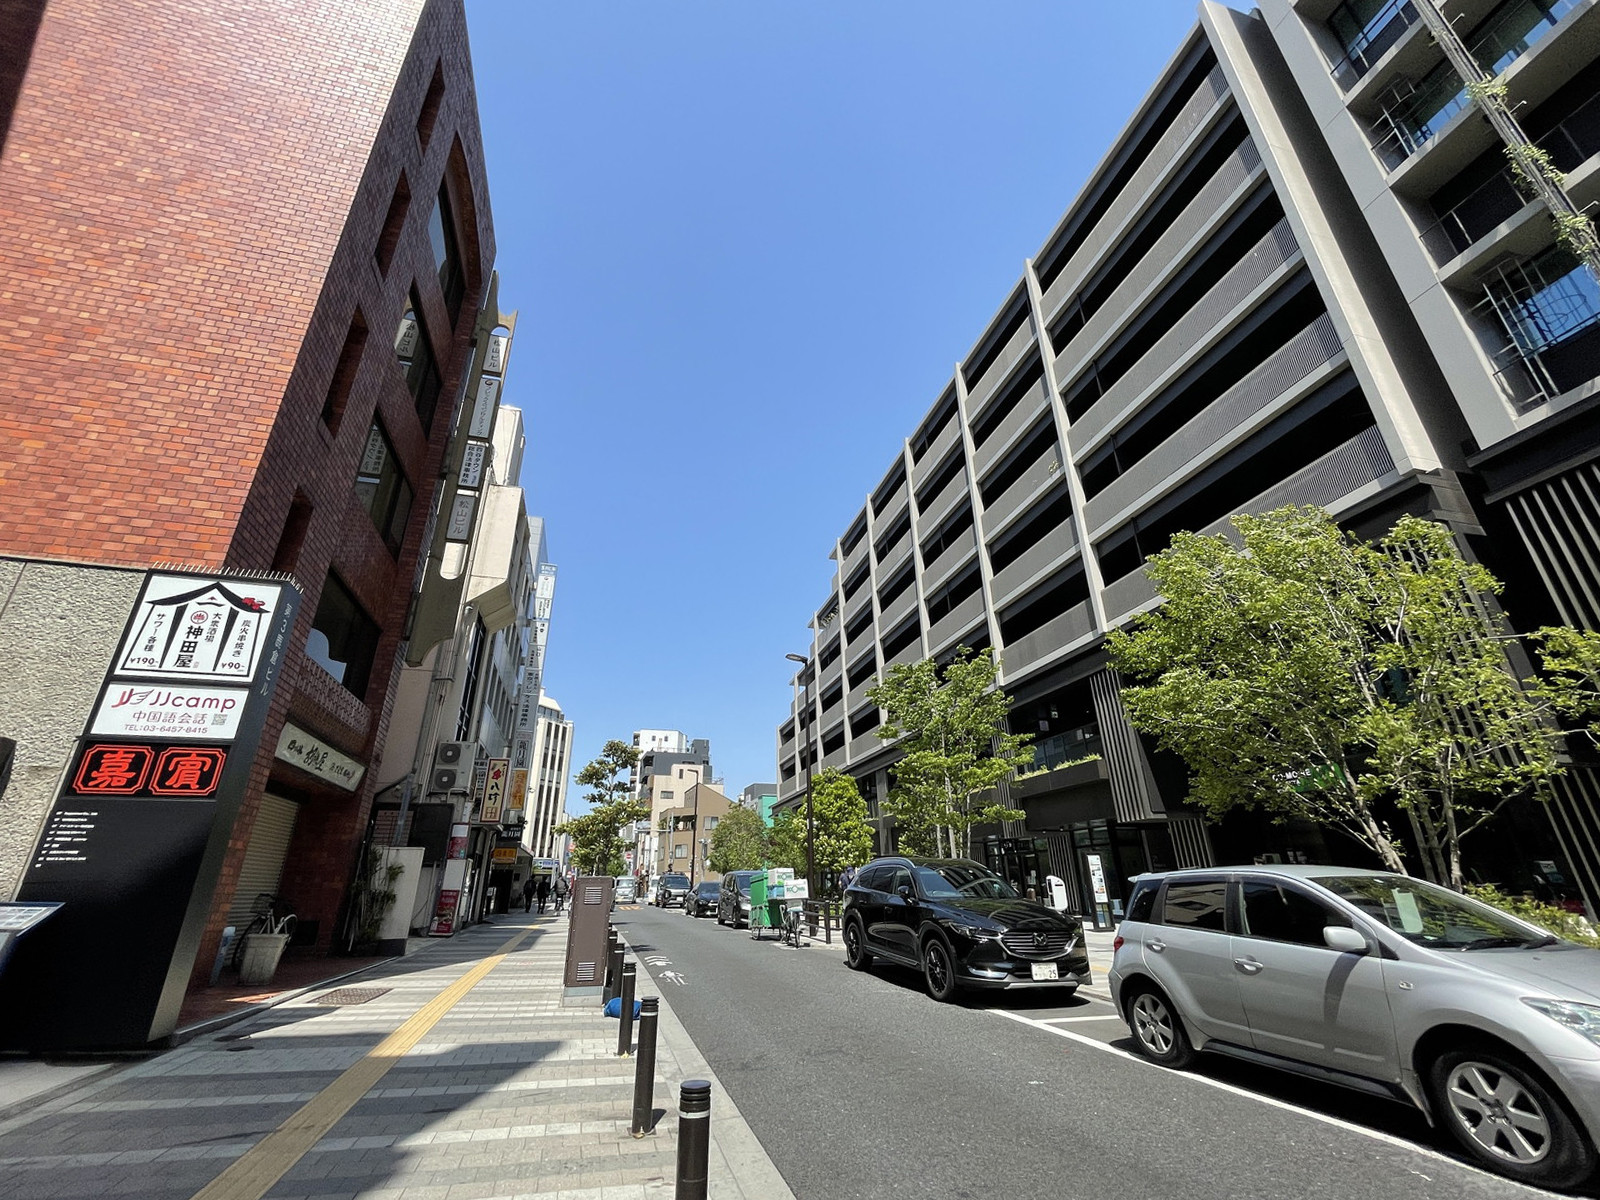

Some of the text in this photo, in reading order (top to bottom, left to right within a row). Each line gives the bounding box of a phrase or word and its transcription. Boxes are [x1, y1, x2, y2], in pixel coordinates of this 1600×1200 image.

[488, 339, 502, 368] 松山ビル
[461, 446, 475, 484] 総合法律事務所
[453, 500, 470, 534] 松山ビル
[143, 613, 166, 652] サワー各種
[204, 613, 222, 643] 大衆酒場
[232, 619, 251, 657] 炭火串焼き
[173, 625, 203, 668] 神田屋
[132, 710, 208, 725] 中国語会話
[150, 691, 236, 713] JJcamp
[124, 724, 208, 734] TEL:03-6457-8415
